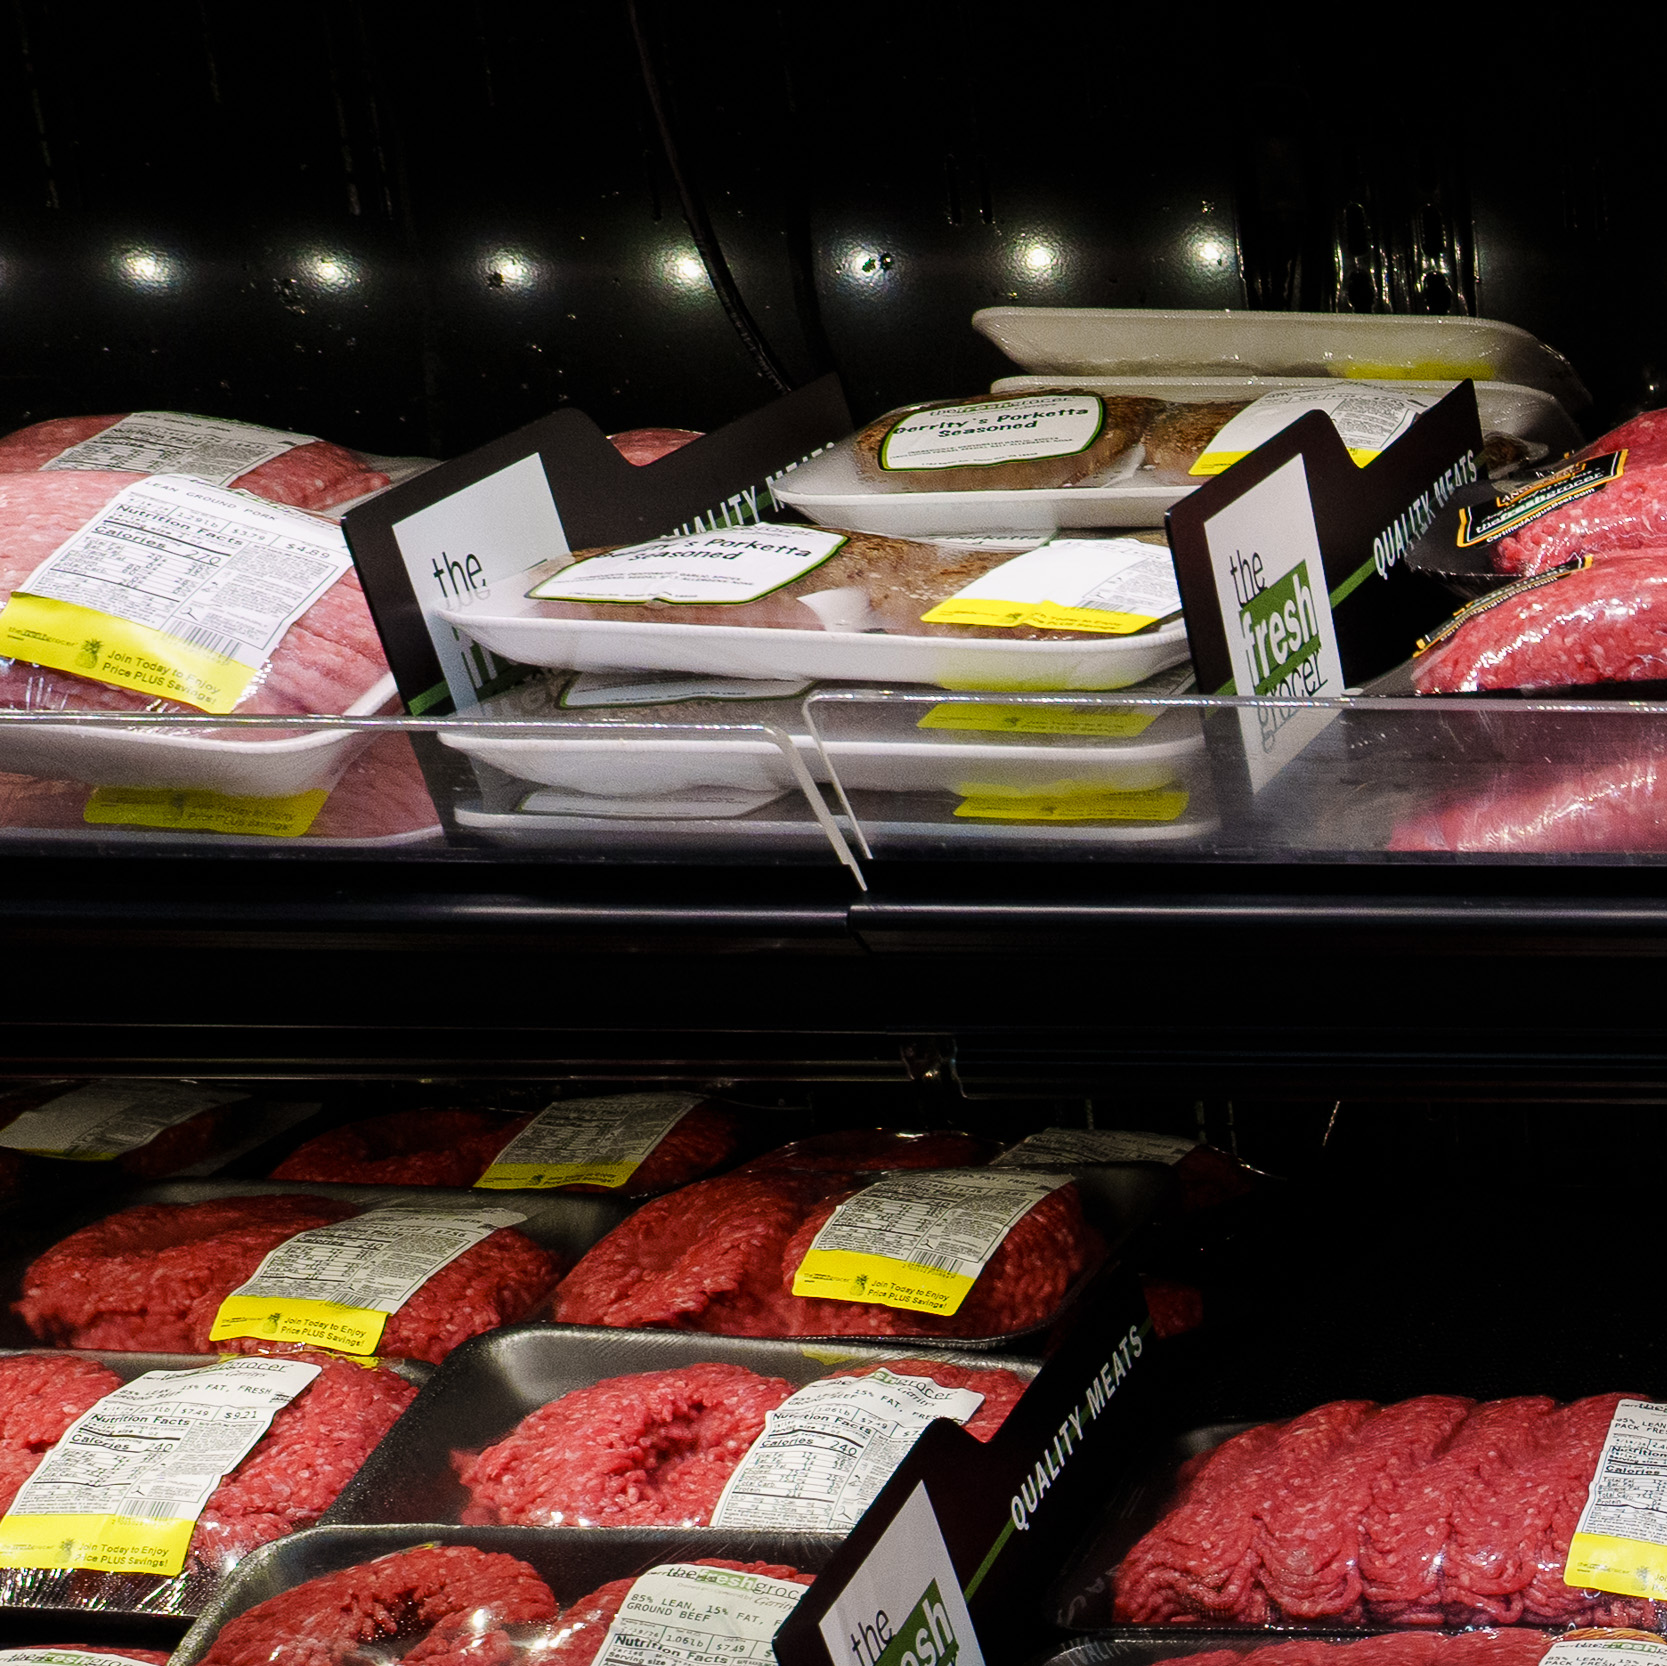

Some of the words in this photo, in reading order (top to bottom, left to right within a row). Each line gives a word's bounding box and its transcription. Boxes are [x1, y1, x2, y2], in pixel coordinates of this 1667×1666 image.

[938, 420, 1038, 438] Seasoned
[997, 408, 1089, 423] Porketta
[145, 480, 179, 493] LEAN
[186, 490, 238, 510] GROUND
[116, 504, 191, 530] Nutrition
[197, 525, 244, 546] Facts
[629, 549, 744, 562] Seasoned
[707, 537, 812, 558] Porketta
[433, 551, 487, 597] the
[1230, 550, 1268, 605] the
[1242, 574, 1320, 689] fresh
[102, 662, 131, 678] Price
[134, 670, 165, 686] PLUS
[1009, 1405, 1082, 1531] QUALITY
[1086, 1325, 1144, 1420] MEATS
[626, 1602, 673, 1616] GROUND
[679, 1610, 711, 1622] BEEF
[614, 1636, 680, 1656] Nutrition
[686, 1651, 728, 1665] Facts
